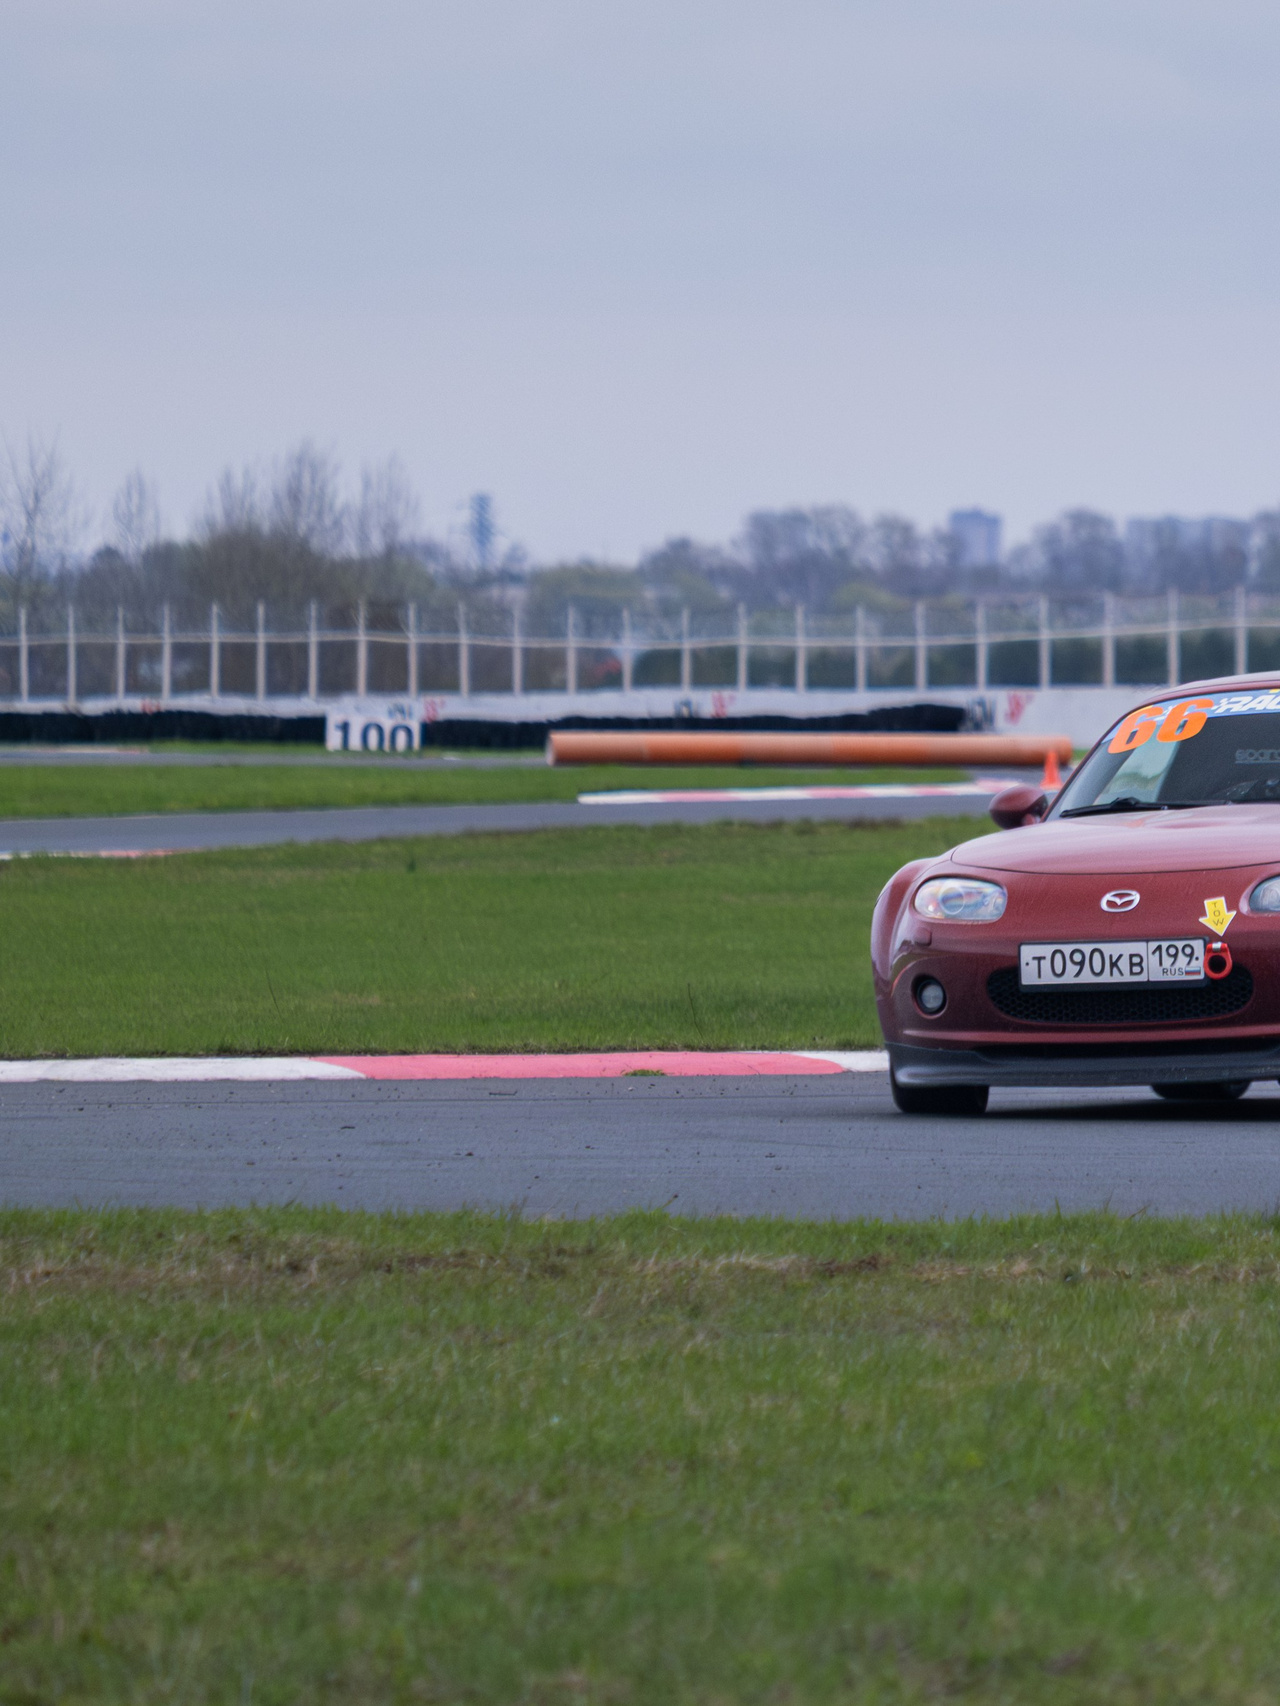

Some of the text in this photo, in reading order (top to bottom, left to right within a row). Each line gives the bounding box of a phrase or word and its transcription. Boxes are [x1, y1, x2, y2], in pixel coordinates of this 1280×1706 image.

[334, 720, 414, 750] 100
[1107, 698, 1214, 754] 66
[1151, 944, 1195, 967] 199
[1162, 967, 1184, 977] RUS
